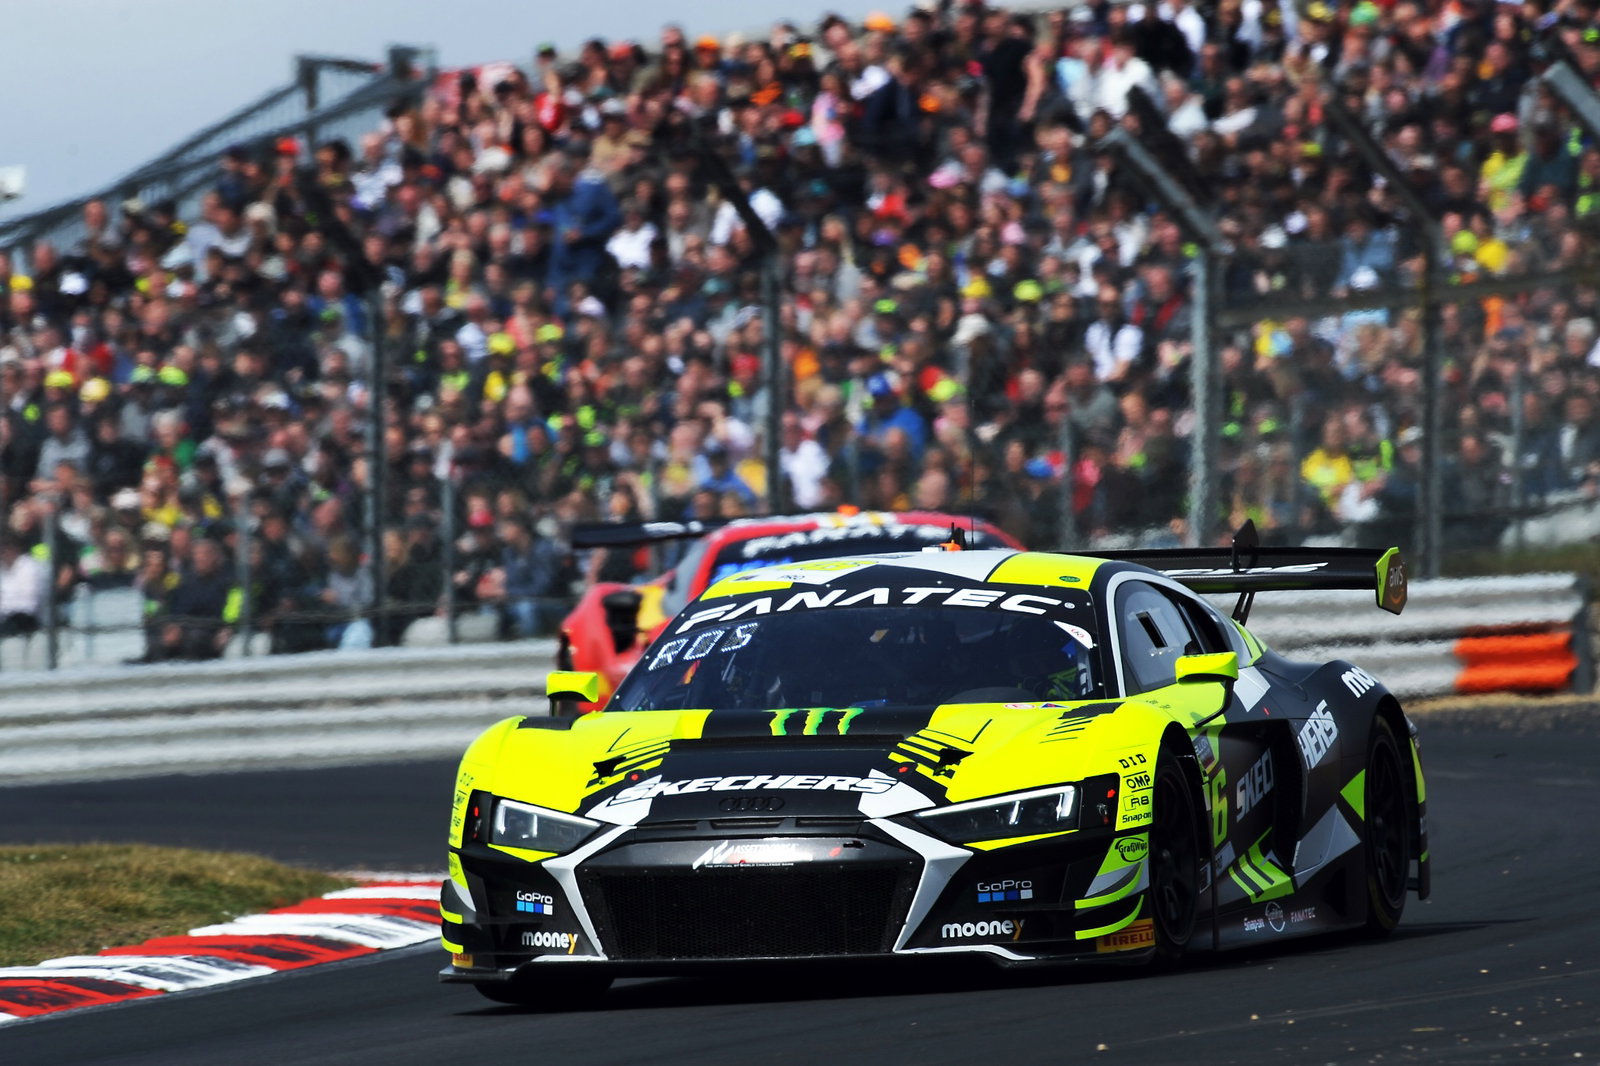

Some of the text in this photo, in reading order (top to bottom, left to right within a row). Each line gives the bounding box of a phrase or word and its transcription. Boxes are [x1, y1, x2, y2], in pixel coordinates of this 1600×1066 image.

[675, 586, 1062, 636] FANATEC
[1118, 753, 1147, 769] DID
[1126, 774, 1151, 789] OMP
[606, 774, 898, 807] SKECHERS
[1130, 795, 1150, 808] R8
[977, 879, 1032, 892] GoPro
[516, 890, 553, 904] GoPro
[942, 919, 1025, 941] mooney
[521, 931, 578, 955] mooney
